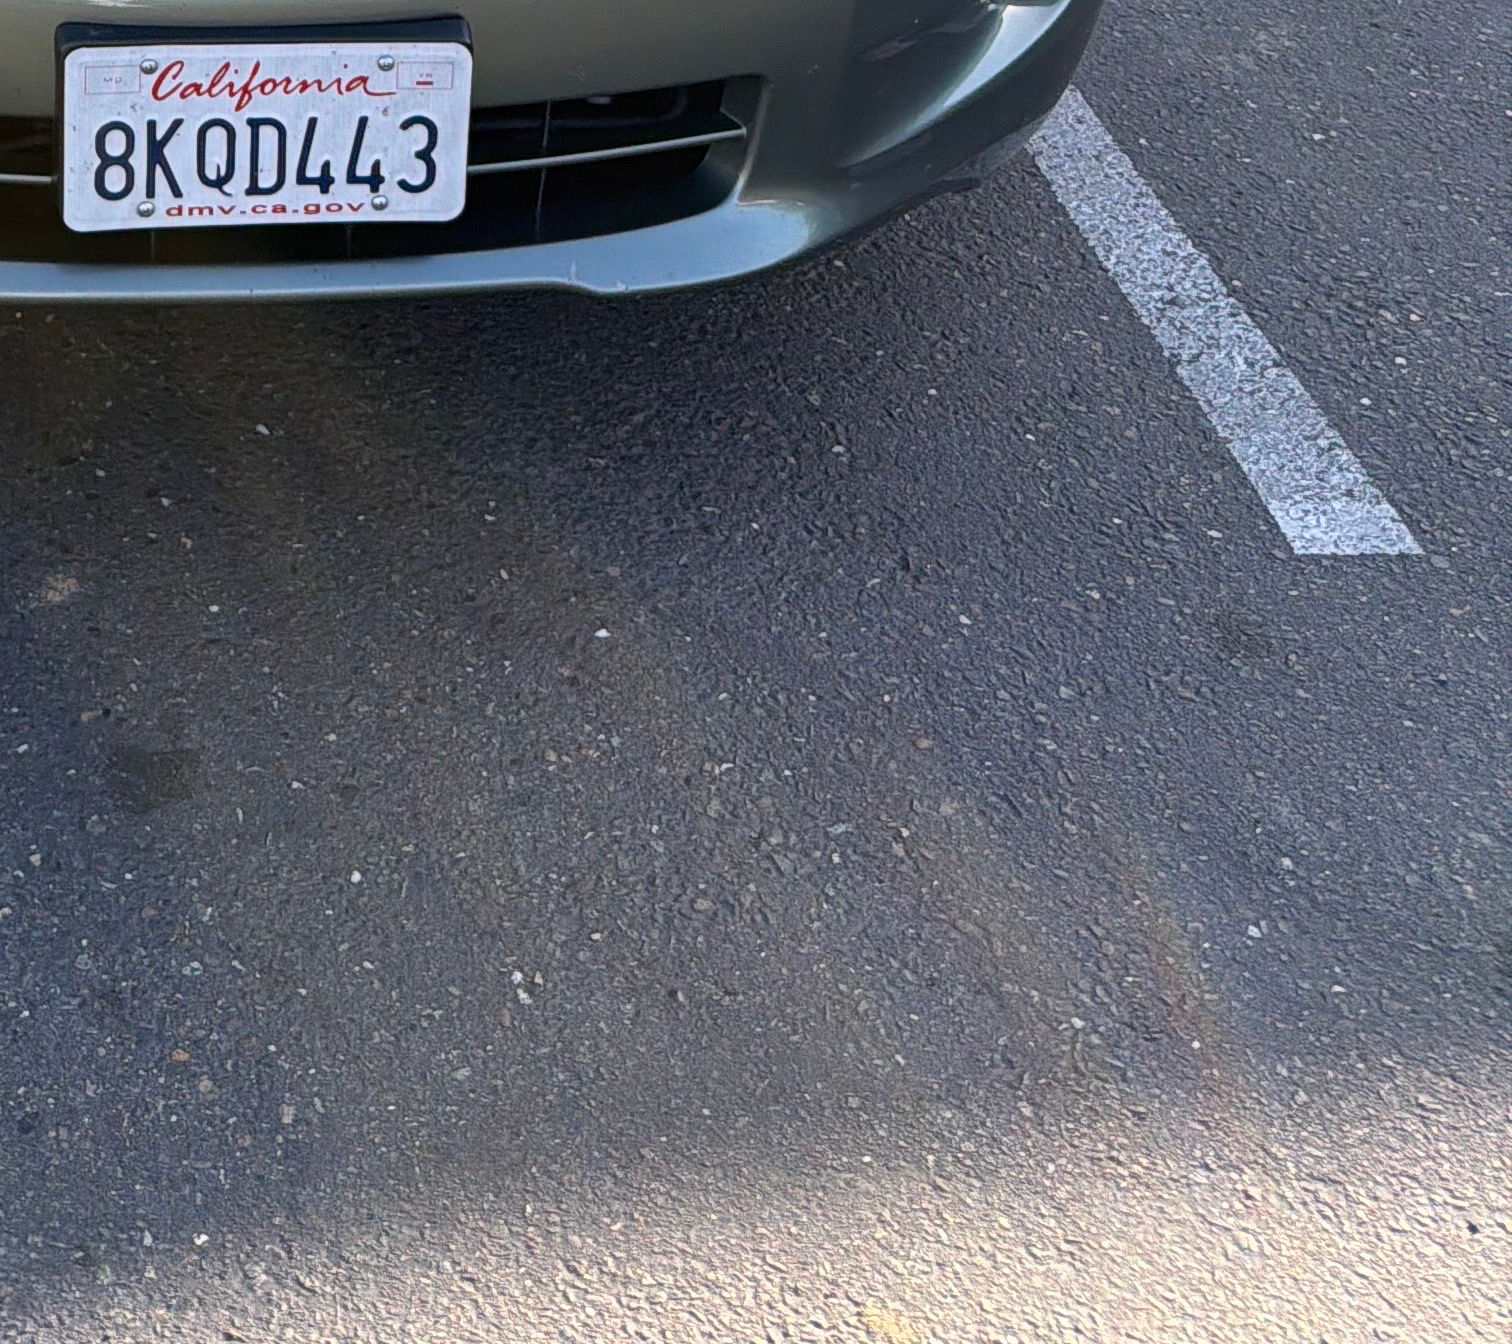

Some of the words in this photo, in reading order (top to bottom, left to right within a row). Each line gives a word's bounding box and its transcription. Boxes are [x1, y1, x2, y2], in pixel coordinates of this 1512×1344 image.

[151, 60, 397, 113] California
[93, 114, 439, 202] 8KQD443
[165, 199, 367, 218] dmv.ca.gov
